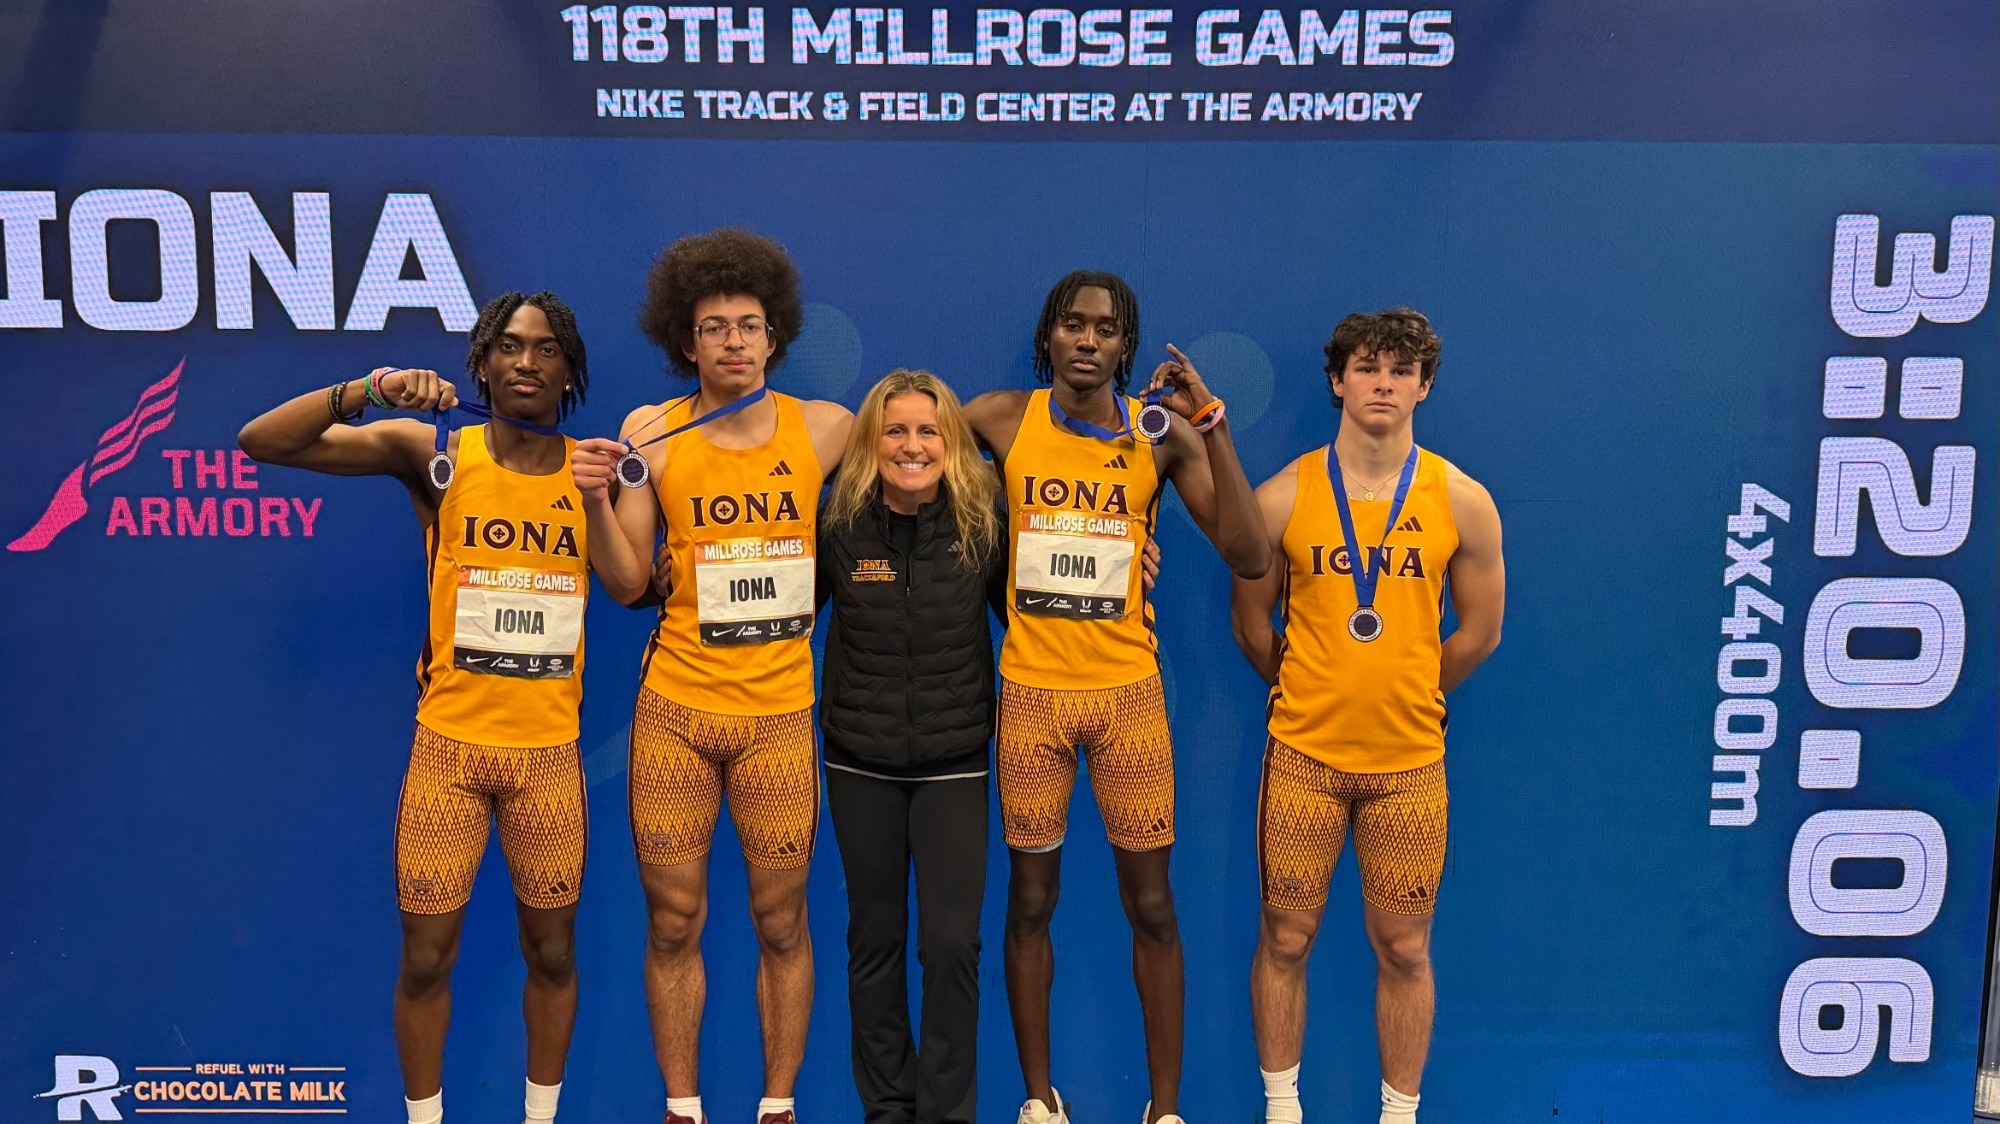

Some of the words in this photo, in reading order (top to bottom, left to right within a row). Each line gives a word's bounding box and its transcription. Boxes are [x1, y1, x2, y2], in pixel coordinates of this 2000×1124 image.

[560, 4, 766, 63] 118TH
[791, 7, 1174, 67] MILLROSE
[1195, 9, 1456, 67] GAMES
[596, 88, 685, 119] NIKE
[693, 90, 814, 120] TRACK
[822, 91, 850, 121] &
[859, 92, 966, 122] FIELD
[976, 91, 1115, 122] CENTER
[1124, 92, 1173, 122] AT
[1181, 92, 1253, 122] THE
[1260, 92, 1424, 122] ARMORY
[0, 188, 481, 332] IONA
[162, 450, 259, 489] THE
[687, 490, 803, 529] IONA
[1022, 475, 1131, 516] IONA
[106, 496, 323, 537] ARMORY
[1030, 513, 1086, 533] MILLROSE
[1087, 517, 1128, 537] GAMES
[460, 514, 583, 559] IONA
[704, 541, 762, 560] MILLROSE
[764, 539, 804, 556] GAMES
[856, 559, 891, 571] IONA
[1050, 553, 1097, 579] IONA
[1308, 544, 1427, 579] IONA
[468, 568, 532, 589] MILLROSE
[534, 573, 577, 592] GAMES
[729, 576, 777, 602] IONA
[494, 608, 545, 635] IONA
[1709, 482, 1791, 827] 4x400m
[1778, 213, 1995, 1077] 3:20.06
[195, 1063, 245, 1075] REFUEL
[248, 1063, 285, 1075] WITH
[133, 1081, 283, 1102] CHOCOLATE
[289, 1081, 347, 1101] MILK
